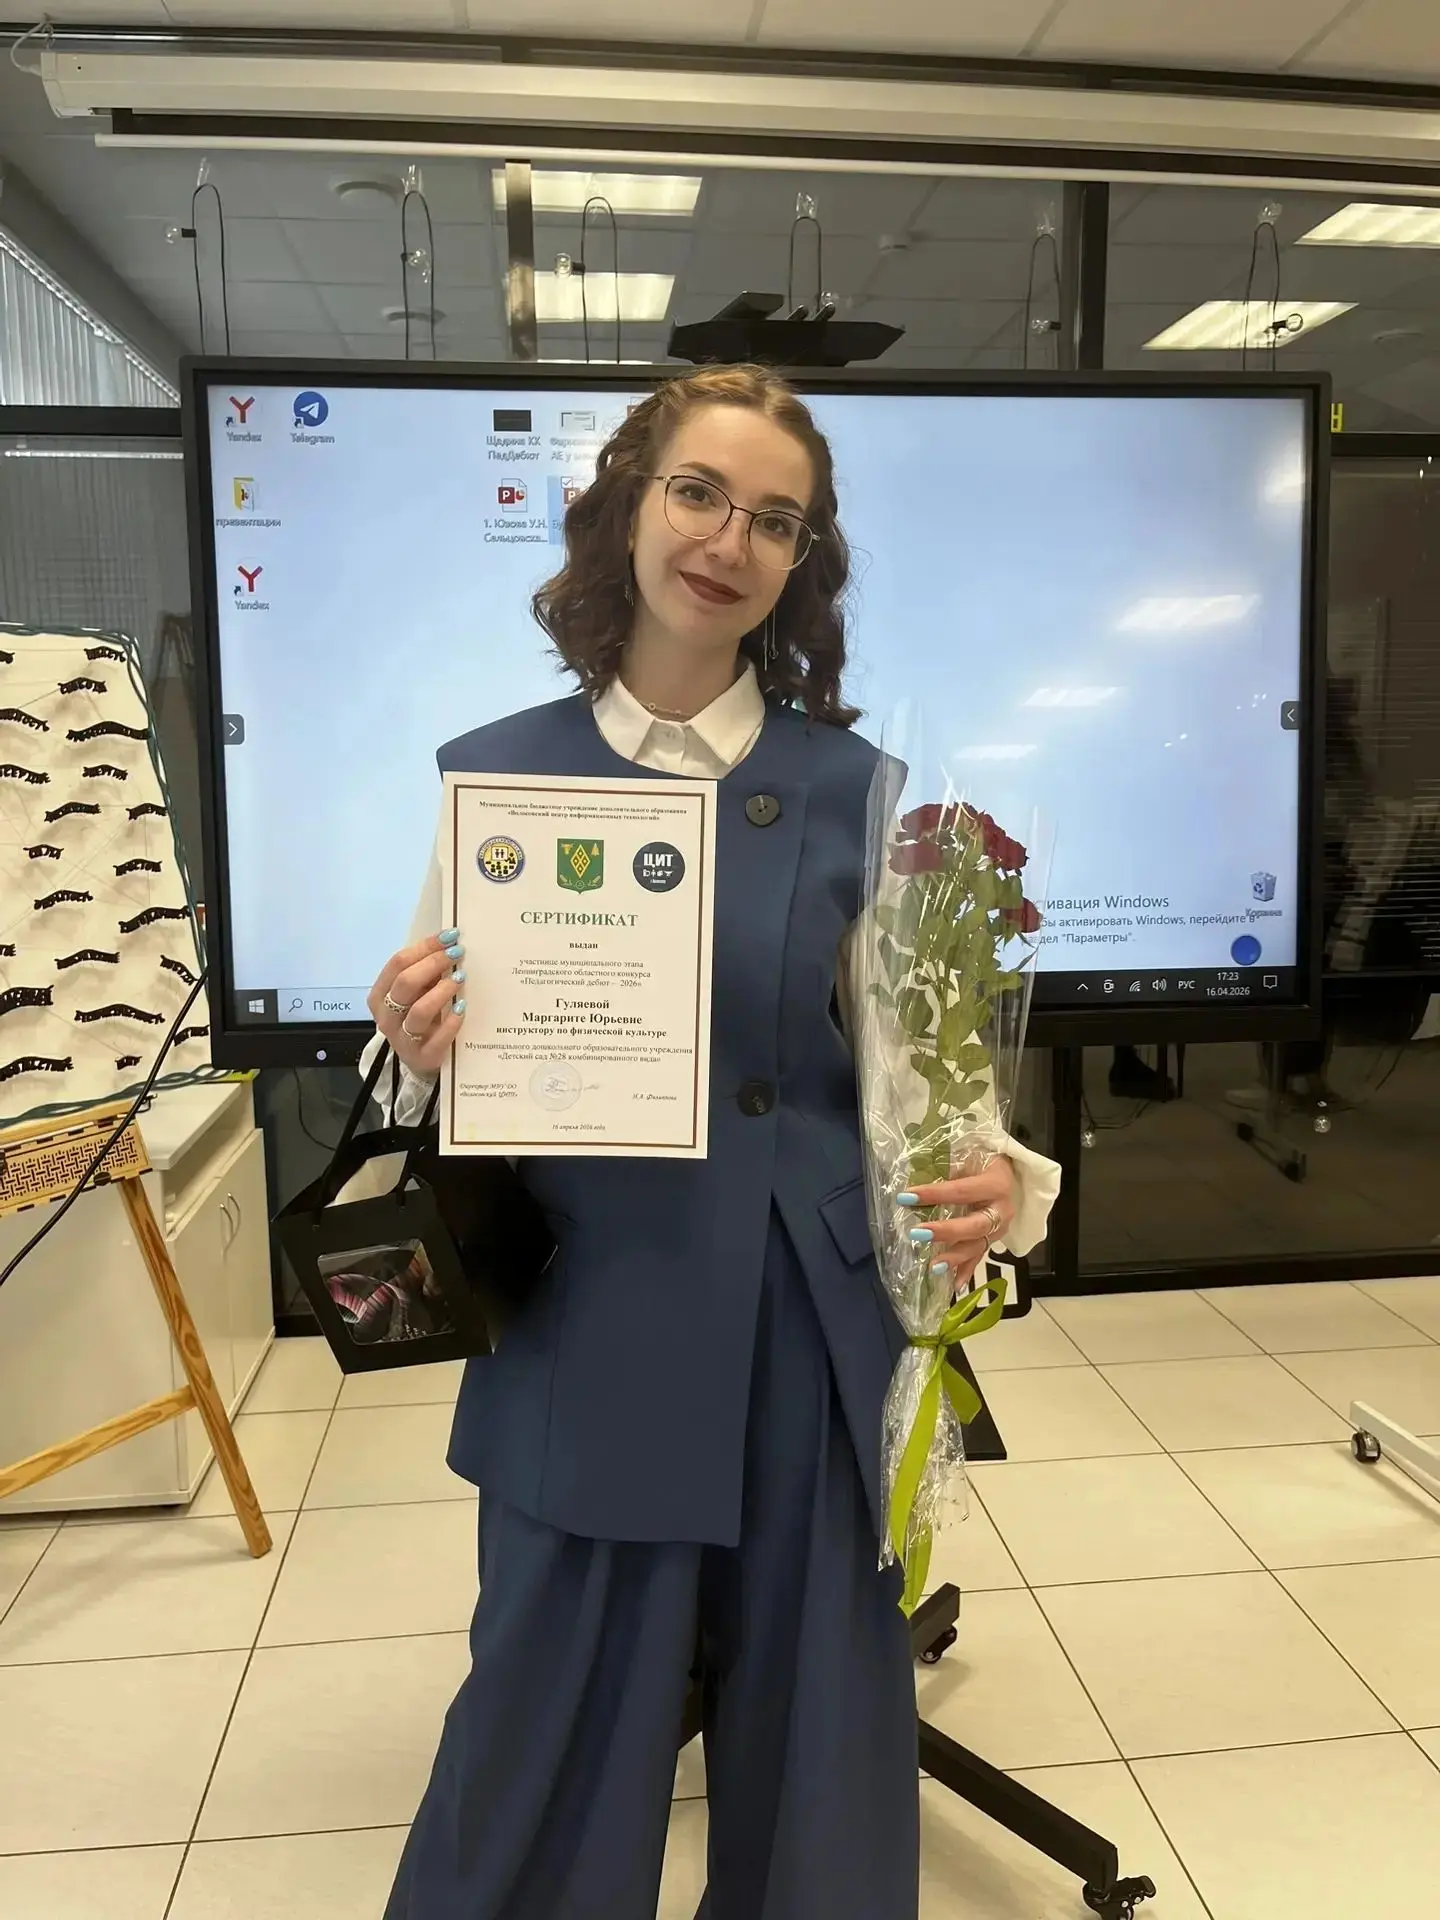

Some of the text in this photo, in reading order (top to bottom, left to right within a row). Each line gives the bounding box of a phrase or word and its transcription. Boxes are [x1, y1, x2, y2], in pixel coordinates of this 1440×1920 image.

[227, 431, 262, 442] Yandex
[290, 432, 335, 445] Telegram
[215, 518, 282, 529] презентации
[484, 518, 493, 528] 1.
[234, 600, 270, 611] Yandex
[643, 853, 673, 868] ЦИТ
[1047, 895, 1169, 912] ивация Windows
[520, 911, 638, 927] СЕРТИФИКАТ
[1059, 917, 1133, 929] активировать
[1136, 915, 1187, 927] Windows,
[1189, 913, 1246, 927] перейдите
[569, 942, 598, 950] выдан
[519, 959, 643, 970] участнице муниципального этапа
[511, 968, 651, 980] Ленинградского областного конкурса
[1217, 971, 1239, 981] 17:23
[520, 977, 584, 988] «Педагогический
[586, 979, 610, 988] дебют
[1178, 980, 1196, 990] РУС
[1205, 986, 1250, 997] 16.04.2026
[313, 1000, 351, 1011] Поиск
[555, 998, 610, 1010] Гуляевой
[522, 1011, 642, 1026] Маргарите Юрьевне
[496, 1026, 667, 1038] инструктору по физической культуре
[465, 1041, 693, 1056] Муниципального дошкольного образовательного учреждения
[497, 1052, 533, 1061] «Детский
[535, 1053, 548, 1062] сад
[568, 1054, 637, 1064] комбинированного
